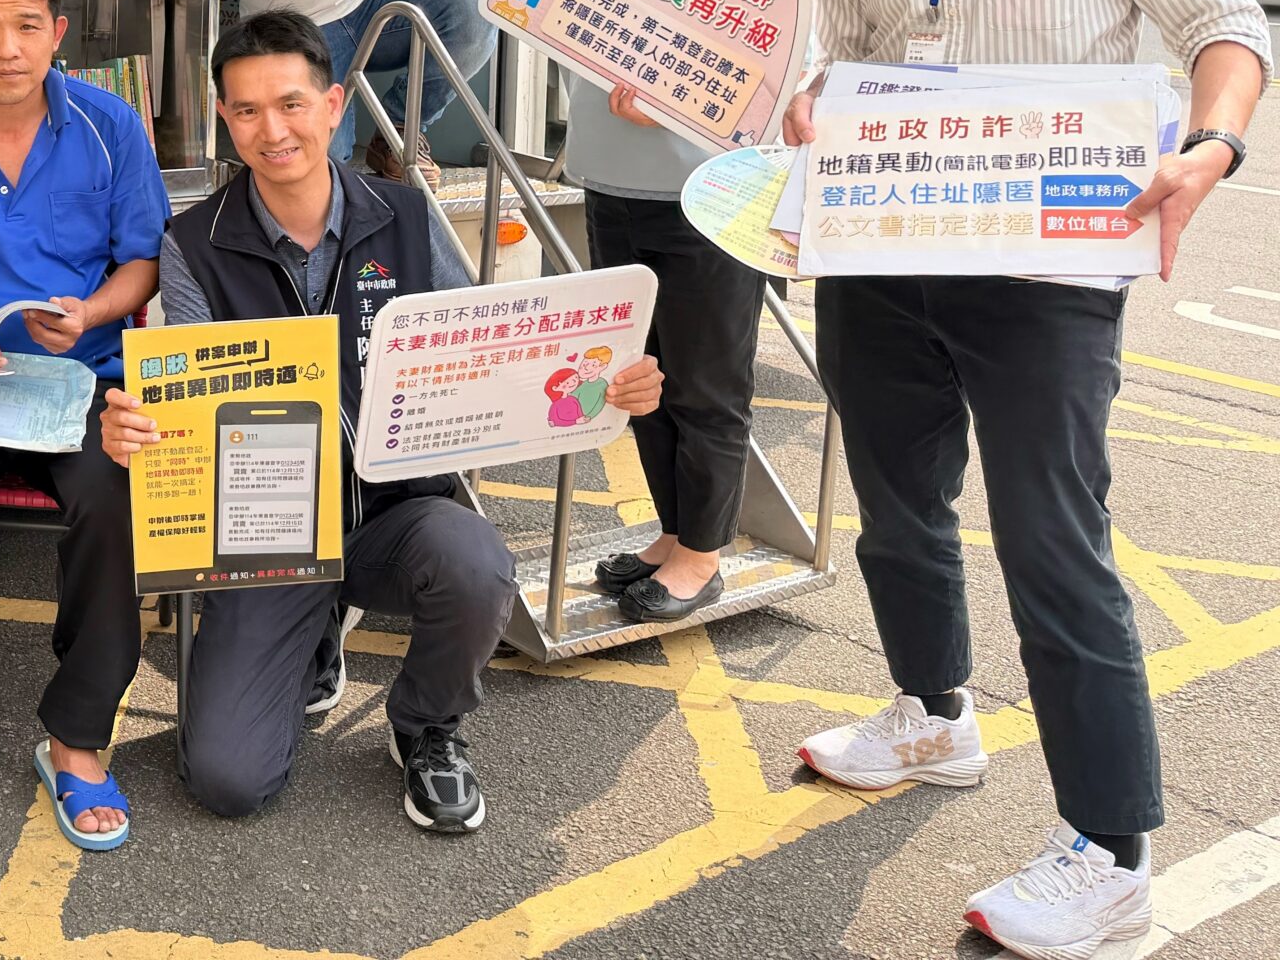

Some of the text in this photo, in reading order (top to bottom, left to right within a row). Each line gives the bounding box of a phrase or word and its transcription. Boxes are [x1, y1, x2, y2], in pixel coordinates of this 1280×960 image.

[856, 81, 945, 95] 印鑑證
[858, 111, 1084, 142] 地政防詐 招
[817, 144, 1147, 177] 地籍異動(簡訊電郵)即時通
[821, 180, 1035, 208] 登記人住址隱匿
[1044, 183, 1130, 199] 地政事務所
[817, 213, 1035, 239] 公文書指定送達
[1045, 214, 1130, 233] 數位櫃台
[356, 279, 396, 291] 臺中市政府
[392, 296, 549, 330] 您不可不知的權利
[386, 302, 634, 354] 夫妻剩餘財產分配請求權
[140, 340, 258, 380] 換狀 併案申辦
[142, 365, 298, 405] 地籍異動即時通
[408, 387, 459, 400] 一方先死亡
[404, 410, 504, 431] 結婚無效或婚姻被撤銷
[406, 407, 426, 416] 離婚
[160, 429, 194, 439] 請了嗎？
[403, 423, 501, 444] 法定財產制改為分別或
[401, 435, 480, 453] 公同共有財產制時
[146, 467, 204, 478] 地籍異動即時通
[148, 513, 206, 525] 申辦後即時掌握
[149, 526, 206, 538] 產權保障好輕鬆
